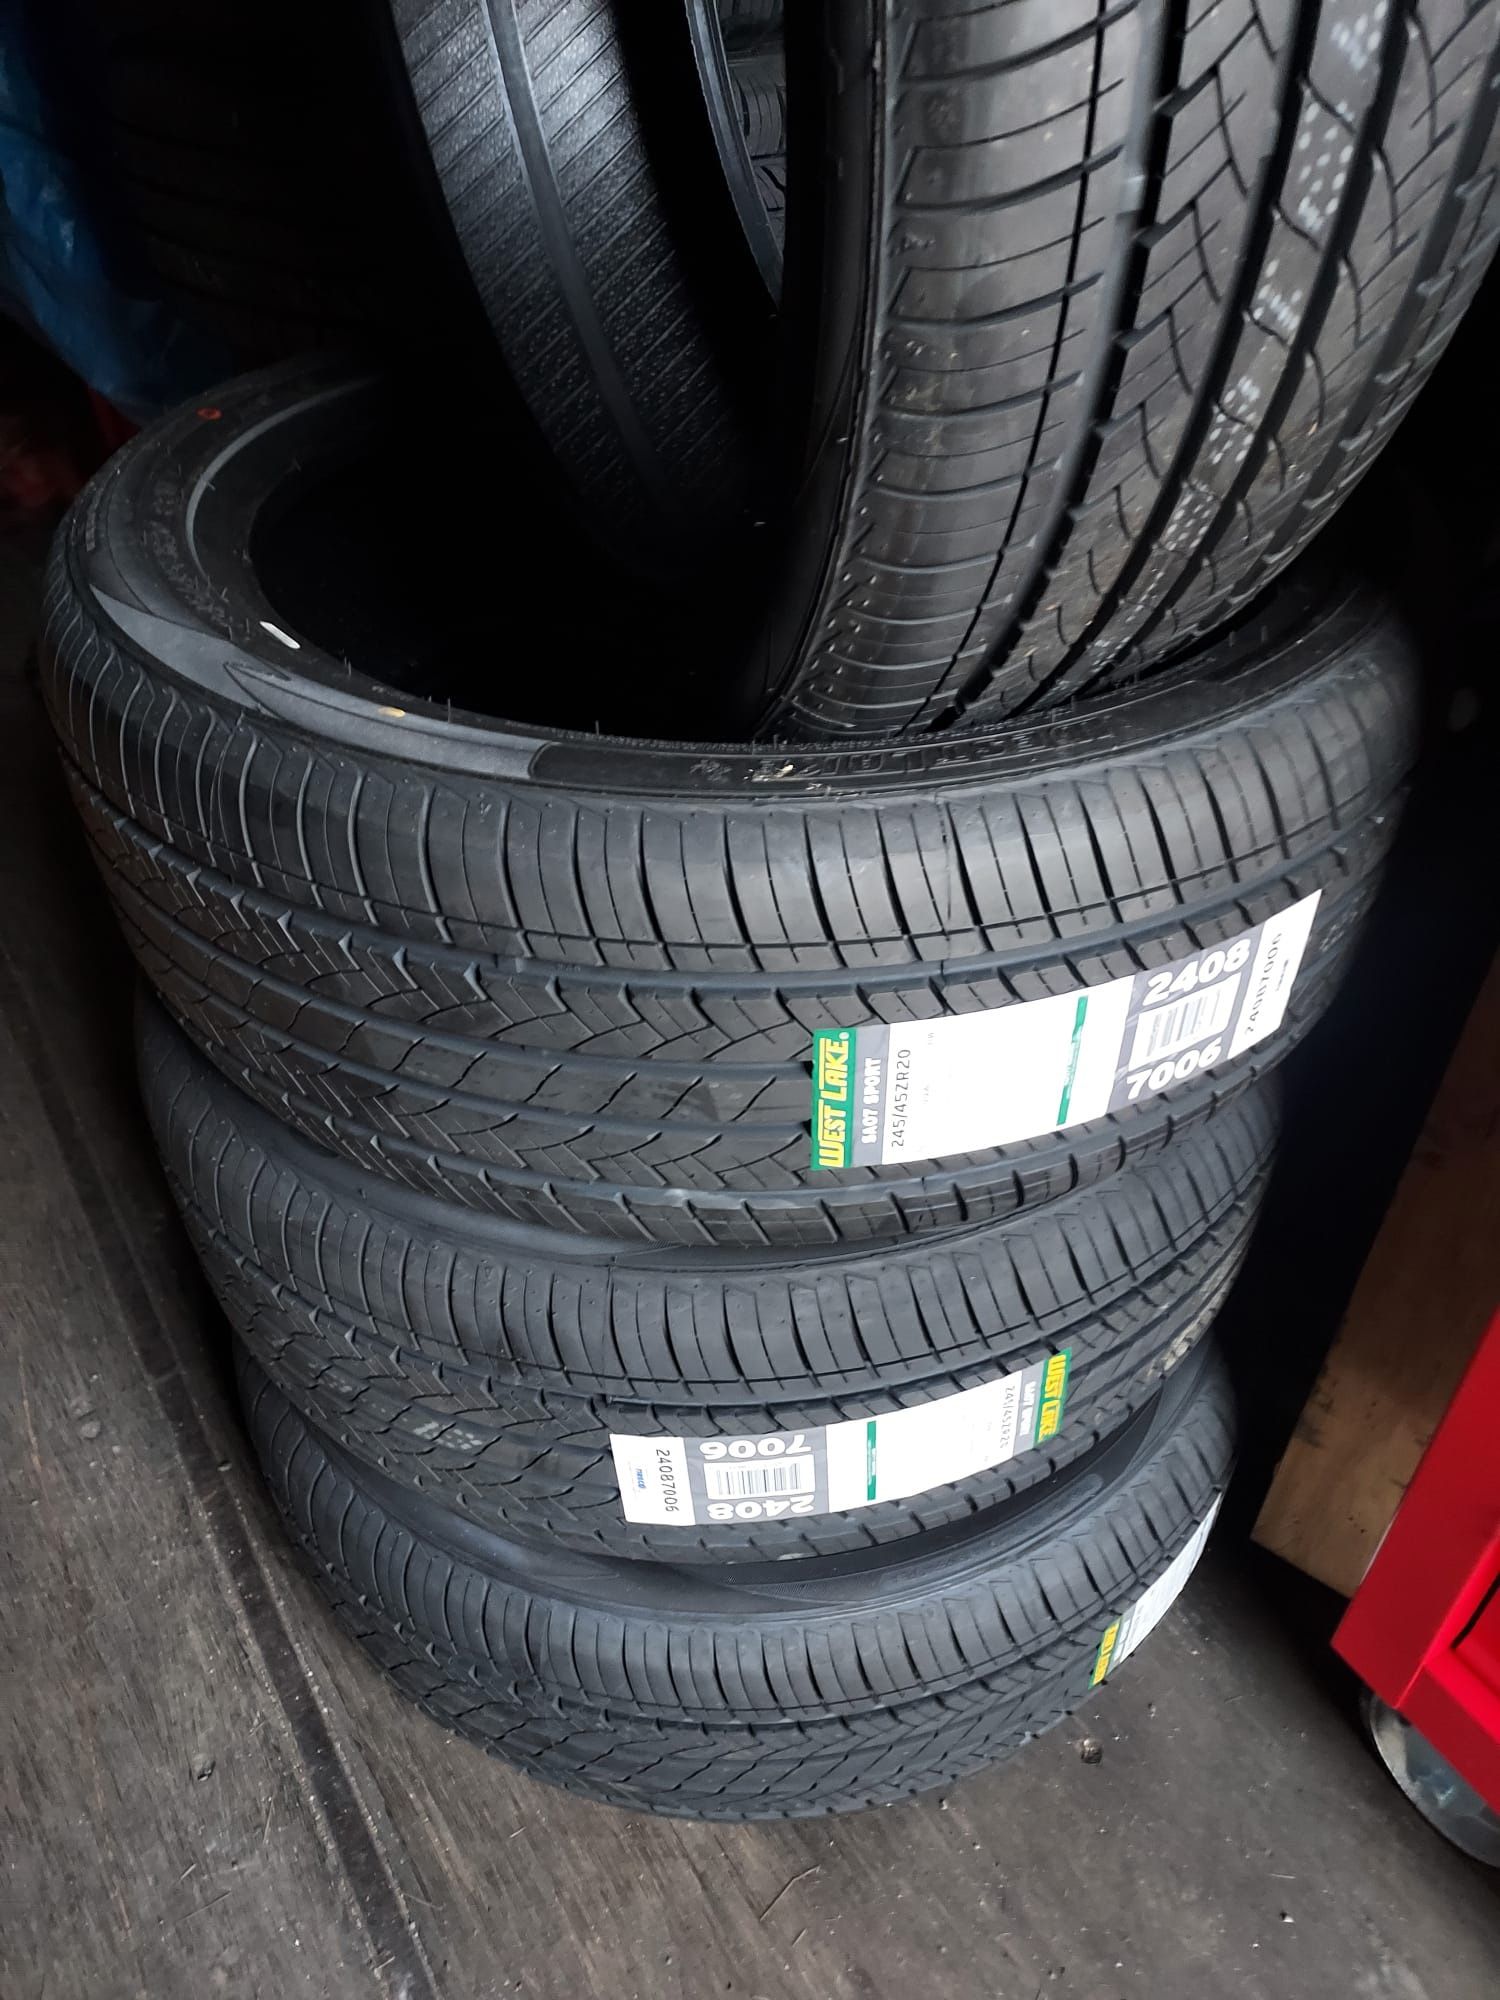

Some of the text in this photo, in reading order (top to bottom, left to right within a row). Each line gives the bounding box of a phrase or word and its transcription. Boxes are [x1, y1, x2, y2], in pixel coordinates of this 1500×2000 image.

[1142, 937, 1252, 1000] 2408
[863, 1057, 882, 1105] SPORT
[890, 1048, 912, 1149] 245/45ZR20
[1126, 1043, 1222, 1099] 7006
[817, 1099, 847, 1168] WEST
[1044, 1355, 1066, 1398] WEST
[698, 1433, 814, 1460] 7006
[655, 1448, 680, 1514] 24087006
[706, 1494, 816, 1521] 2408
